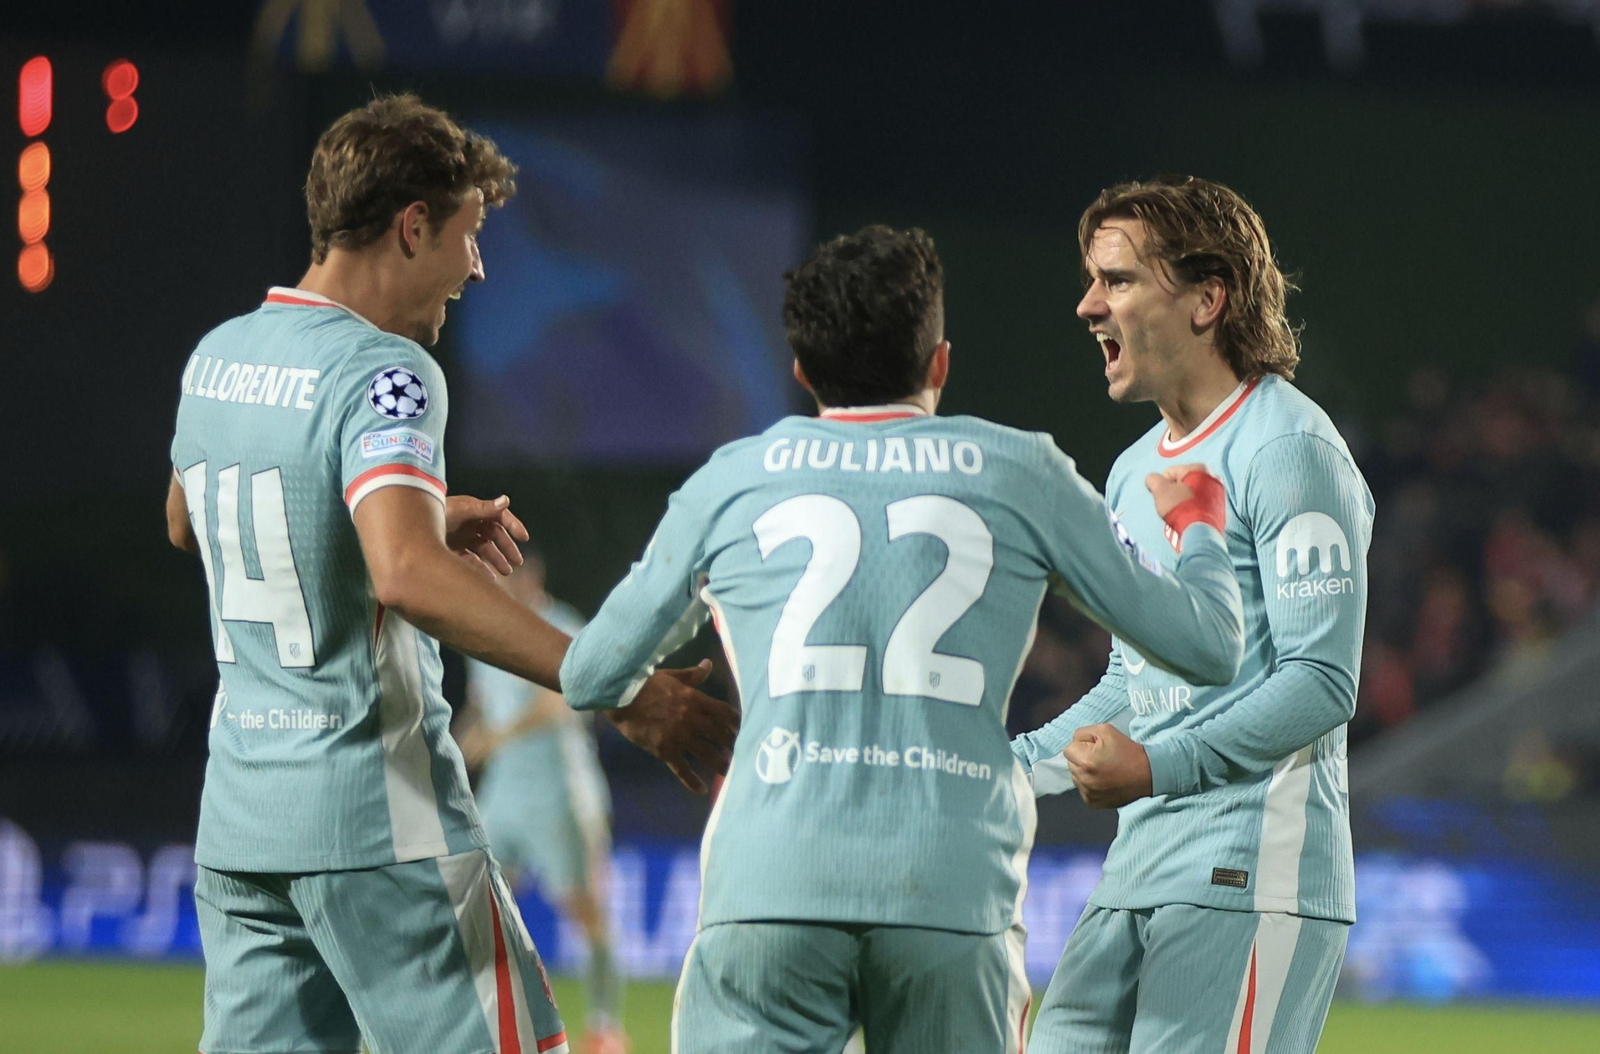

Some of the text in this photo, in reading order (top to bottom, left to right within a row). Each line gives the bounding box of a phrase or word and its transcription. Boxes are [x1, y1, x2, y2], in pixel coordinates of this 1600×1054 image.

[196, 356, 320, 410] LLORENTE
[363, 435, 432, 454] FOUNDATION
[764, 437, 985, 475] GIULIANO
[183, 459, 317, 669] 14
[752, 493, 995, 708] 22
[1276, 577, 1354, 600] kraken
[1159, 685, 1195, 713] AIR
[240, 709, 264, 729] the
[268, 708, 343, 730] Children
[805, 741, 993, 780] Save the Children
